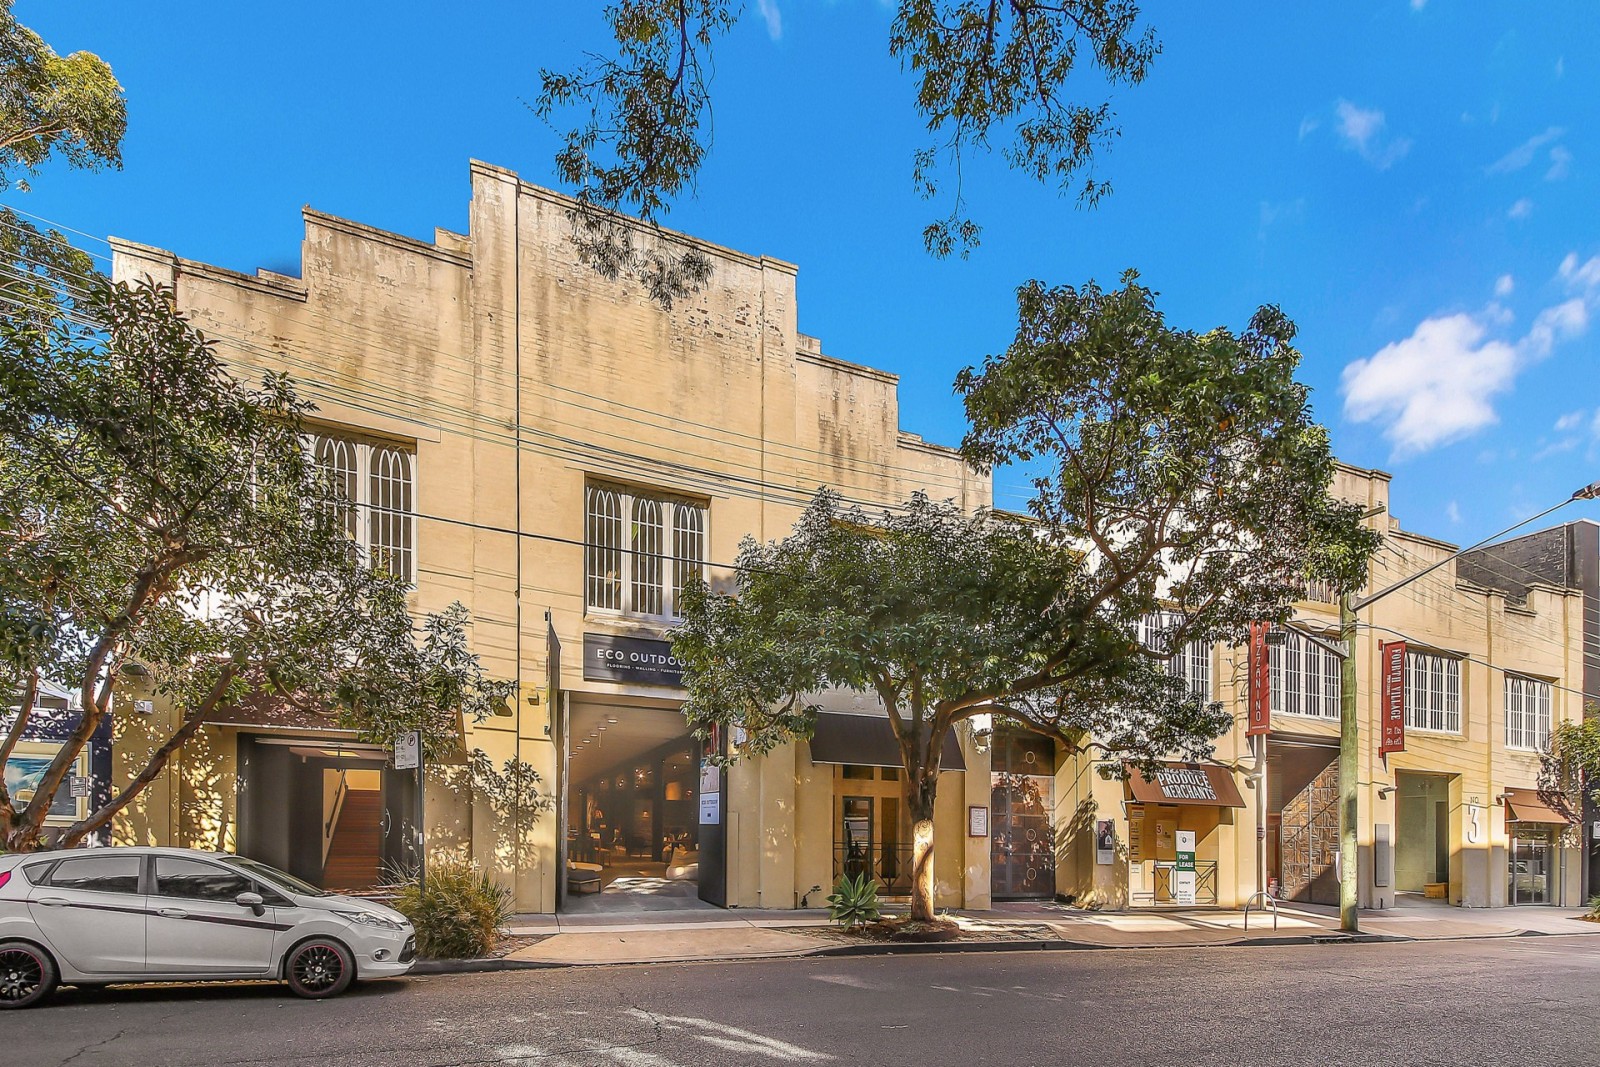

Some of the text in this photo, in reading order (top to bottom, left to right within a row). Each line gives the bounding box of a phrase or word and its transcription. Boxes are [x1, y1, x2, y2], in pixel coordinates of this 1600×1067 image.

[596, 648, 625, 661] ECO
[1390, 648, 1402, 721] FOURTH VILLAGE
[1156, 772, 1212, 789] PRODUCE
[1161, 784, 1217, 800] MERCHANTS
[1467, 804, 1481, 844] 3
